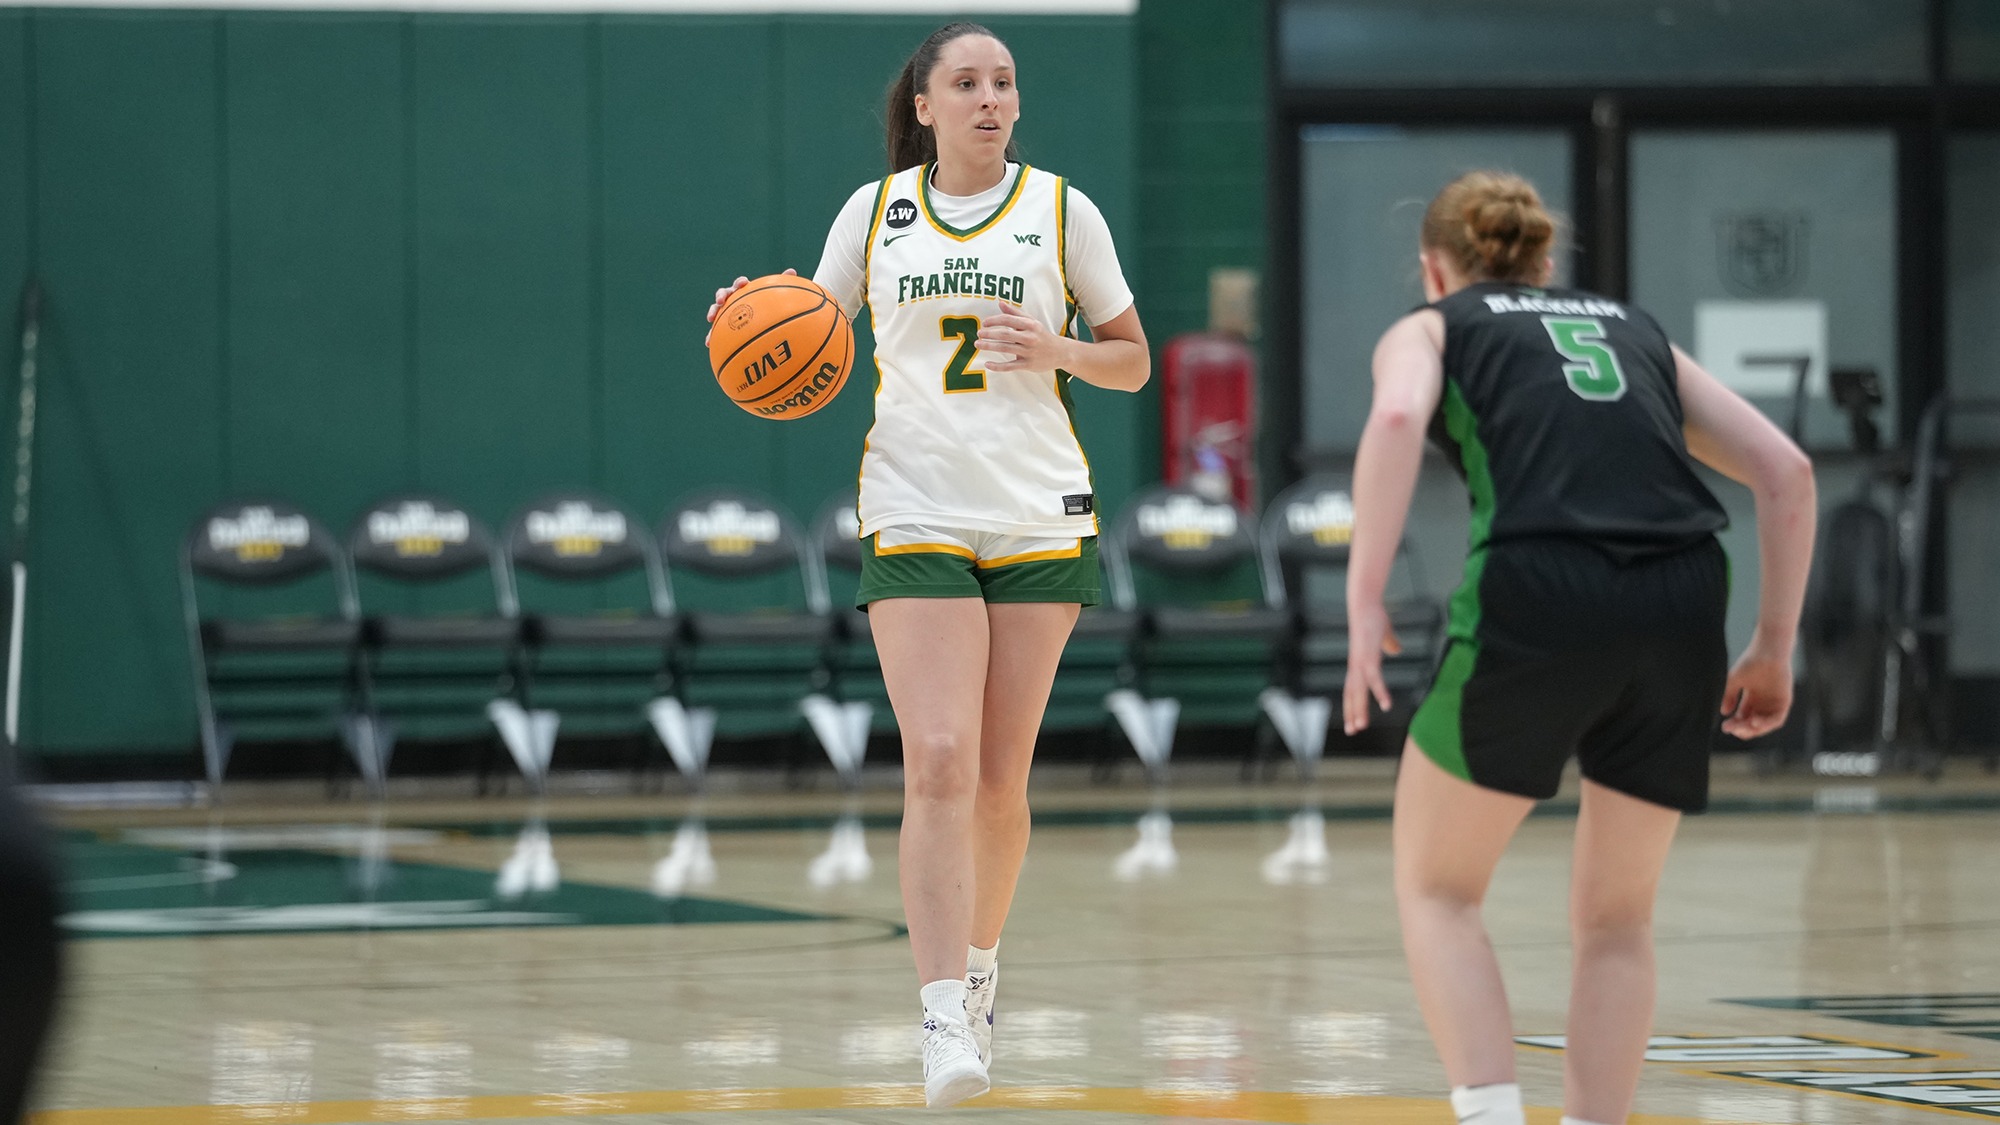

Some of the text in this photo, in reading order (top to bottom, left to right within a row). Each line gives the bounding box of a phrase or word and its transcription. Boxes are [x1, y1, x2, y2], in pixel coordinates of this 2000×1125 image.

[887, 207, 915, 221] LW
[1013, 233, 1042, 247] WCC
[944, 257, 979, 270] SAN
[898, 272, 1024, 303] FRANCISCO
[744, 340, 792, 386] EVO
[939, 315, 987, 394] 2
[1540, 314, 1628, 401] 5
[754, 362, 840, 415] Wilson
